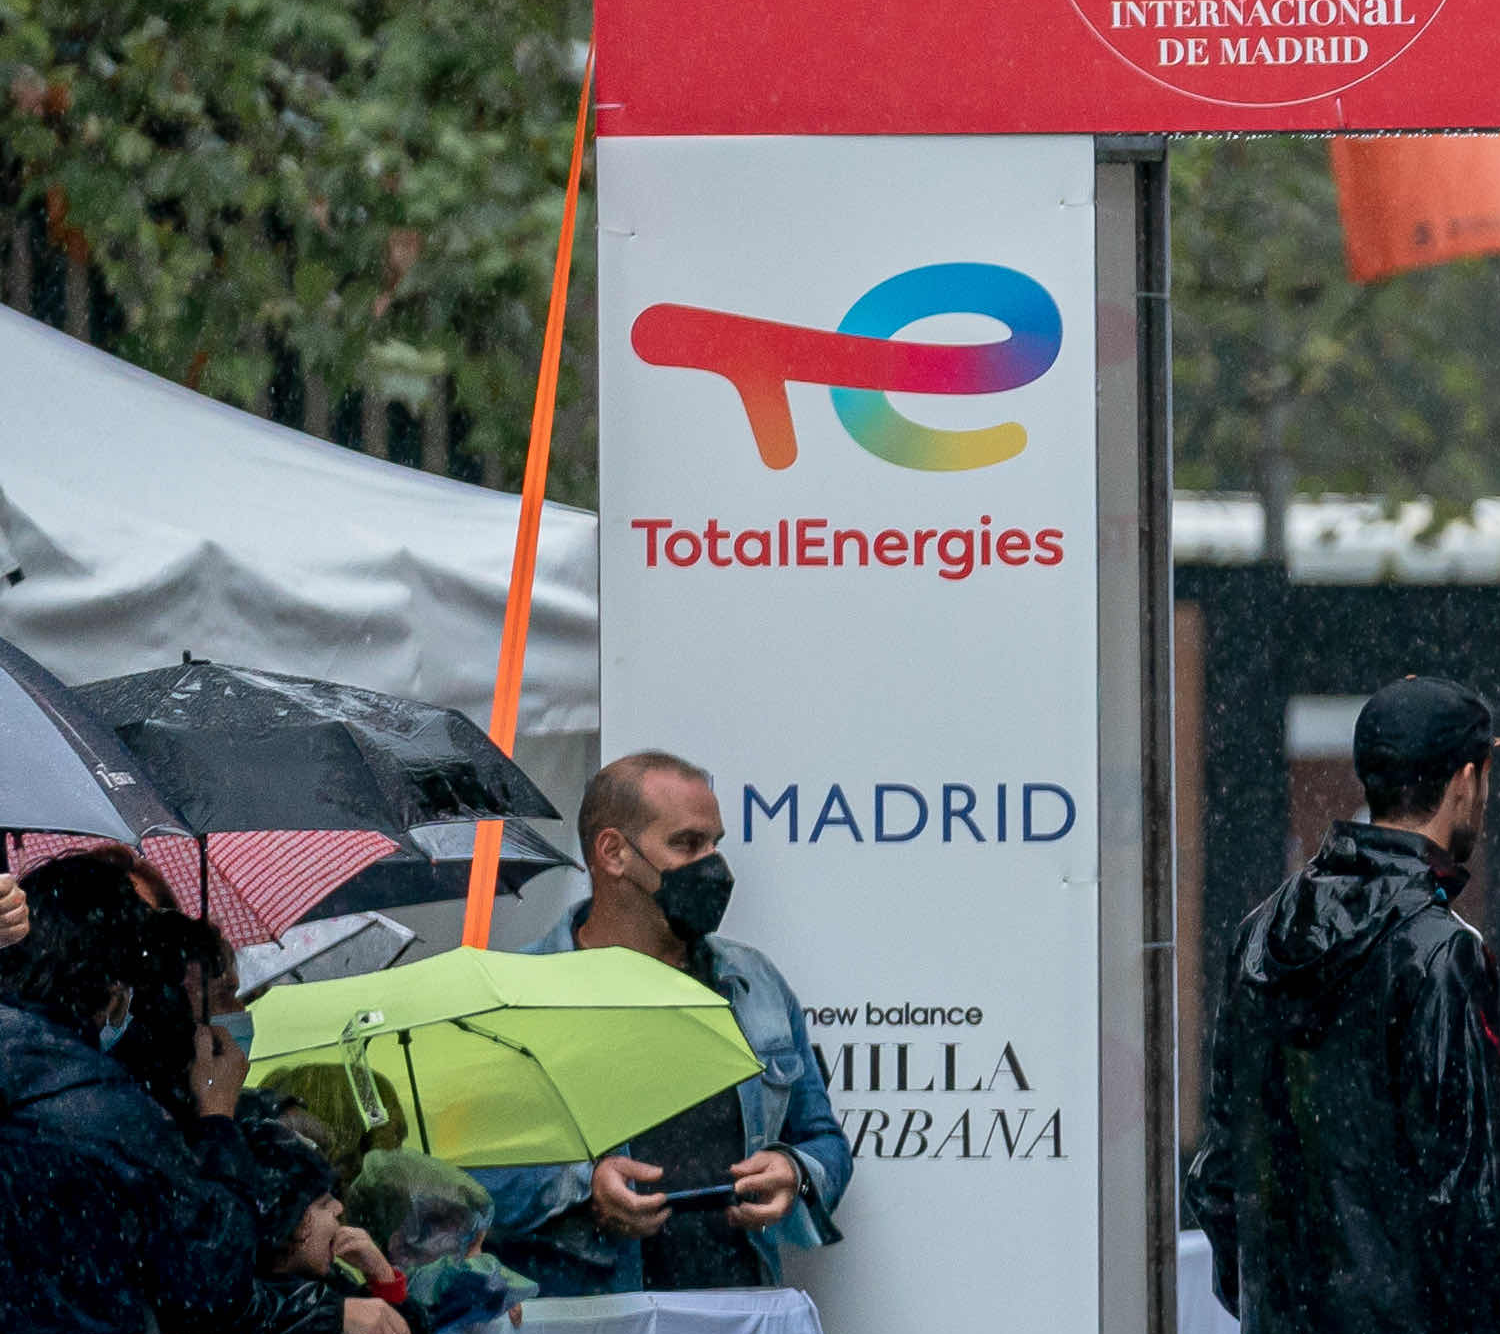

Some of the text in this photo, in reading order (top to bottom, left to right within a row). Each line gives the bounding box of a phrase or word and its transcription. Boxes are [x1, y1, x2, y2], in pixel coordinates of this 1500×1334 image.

[1157, 35, 1370, 66] DE MADRID
[631, 514, 1064, 581] TotalEnergies
[743, 782, 1077, 844] MADRID
[802, 1001, 984, 1027] new balance
[812, 1041, 1035, 1092] MILLA
[838, 1108, 1070, 1160] RBANA
